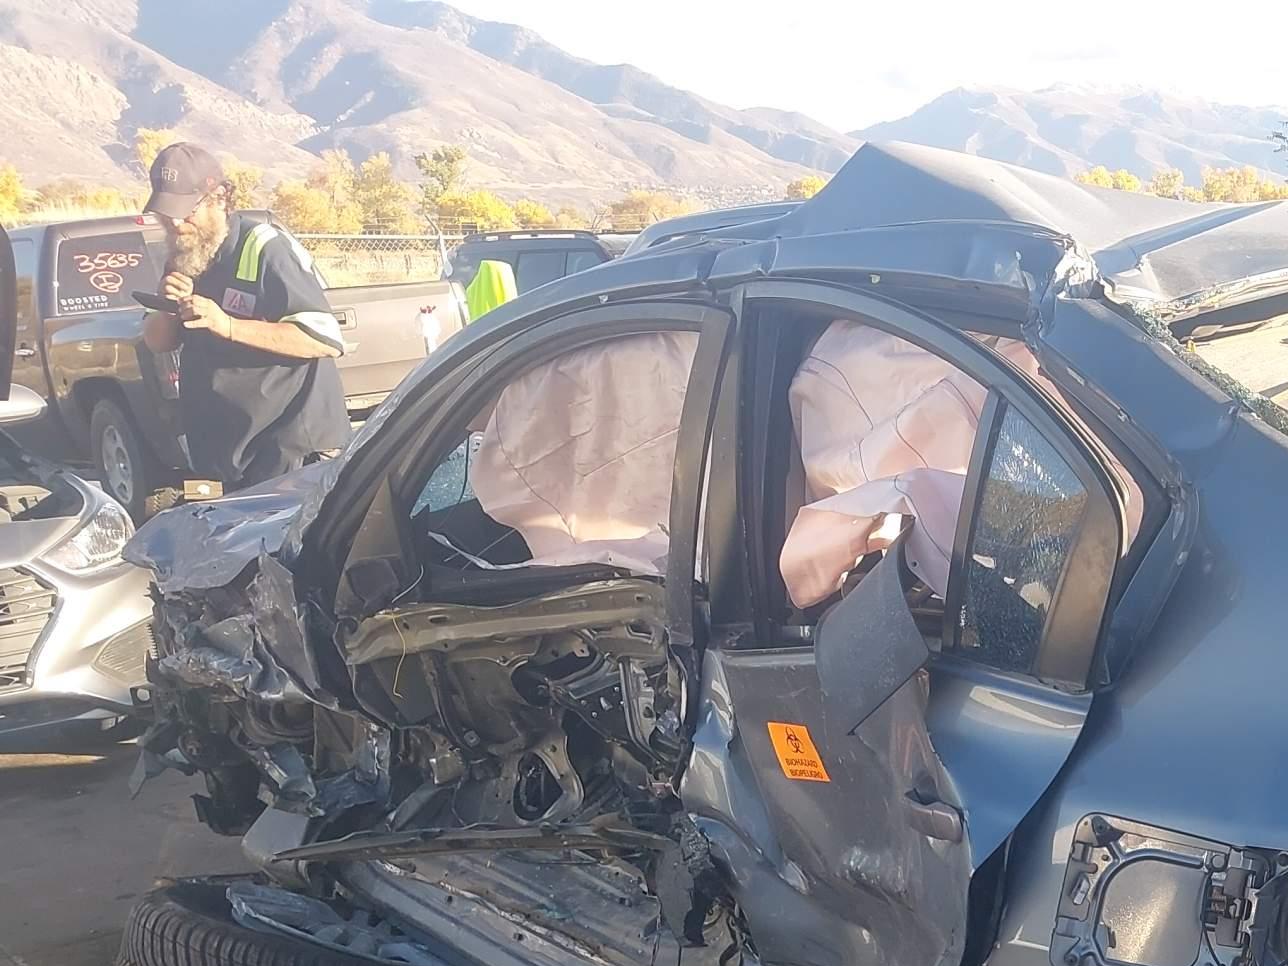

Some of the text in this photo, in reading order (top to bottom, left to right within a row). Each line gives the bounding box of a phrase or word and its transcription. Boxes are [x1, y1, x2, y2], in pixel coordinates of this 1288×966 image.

[60, 295, 108, 306] BOOSTED
[785, 758, 818, 768] BIOHAZARD
[789, 769, 824, 779] BIOPELIGRO
